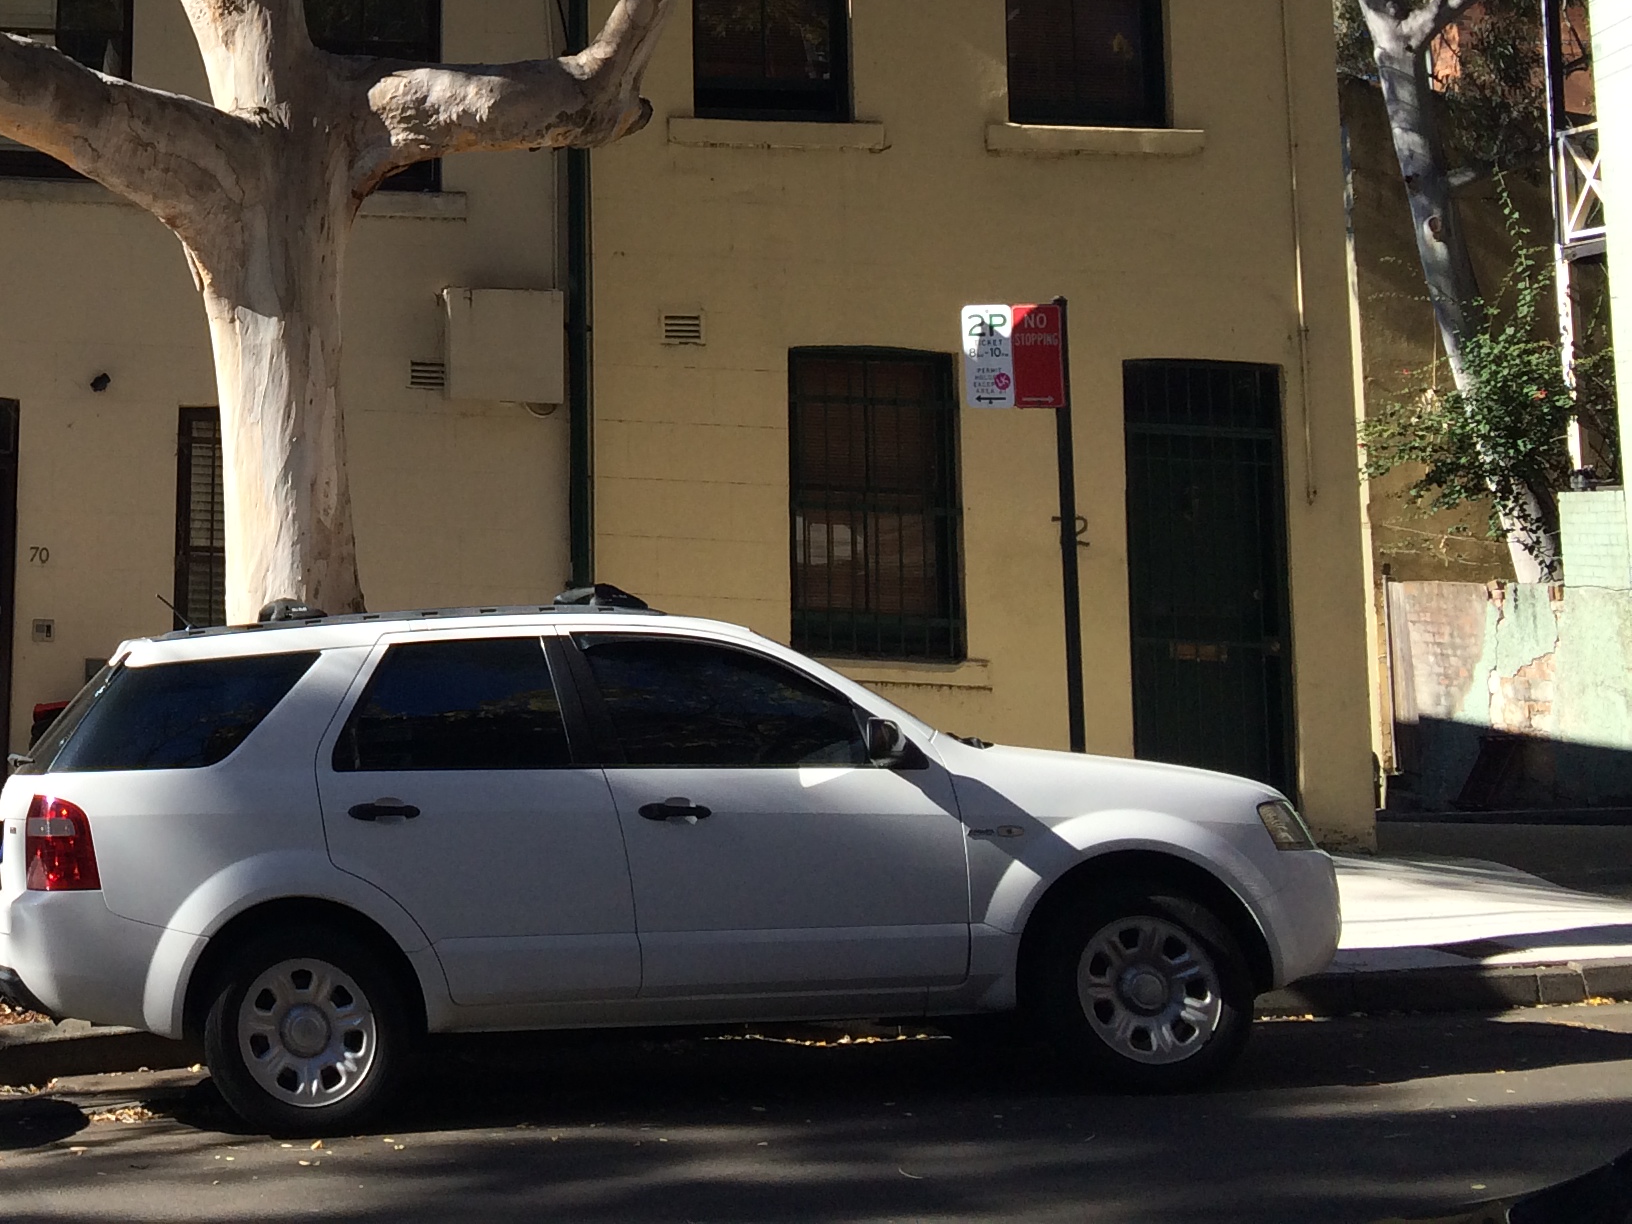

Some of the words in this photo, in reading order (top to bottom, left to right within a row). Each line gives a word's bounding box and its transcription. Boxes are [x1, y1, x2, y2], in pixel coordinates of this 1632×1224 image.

[968, 313, 1007, 336] 2P
[1024, 313, 1047, 328] NO
[1015, 332, 1059, 346] STOPPING
[969, 347, 1009, 357] 8-10
[1051, 516, 1090, 546] 2
[30, 546, 49, 564] 70
